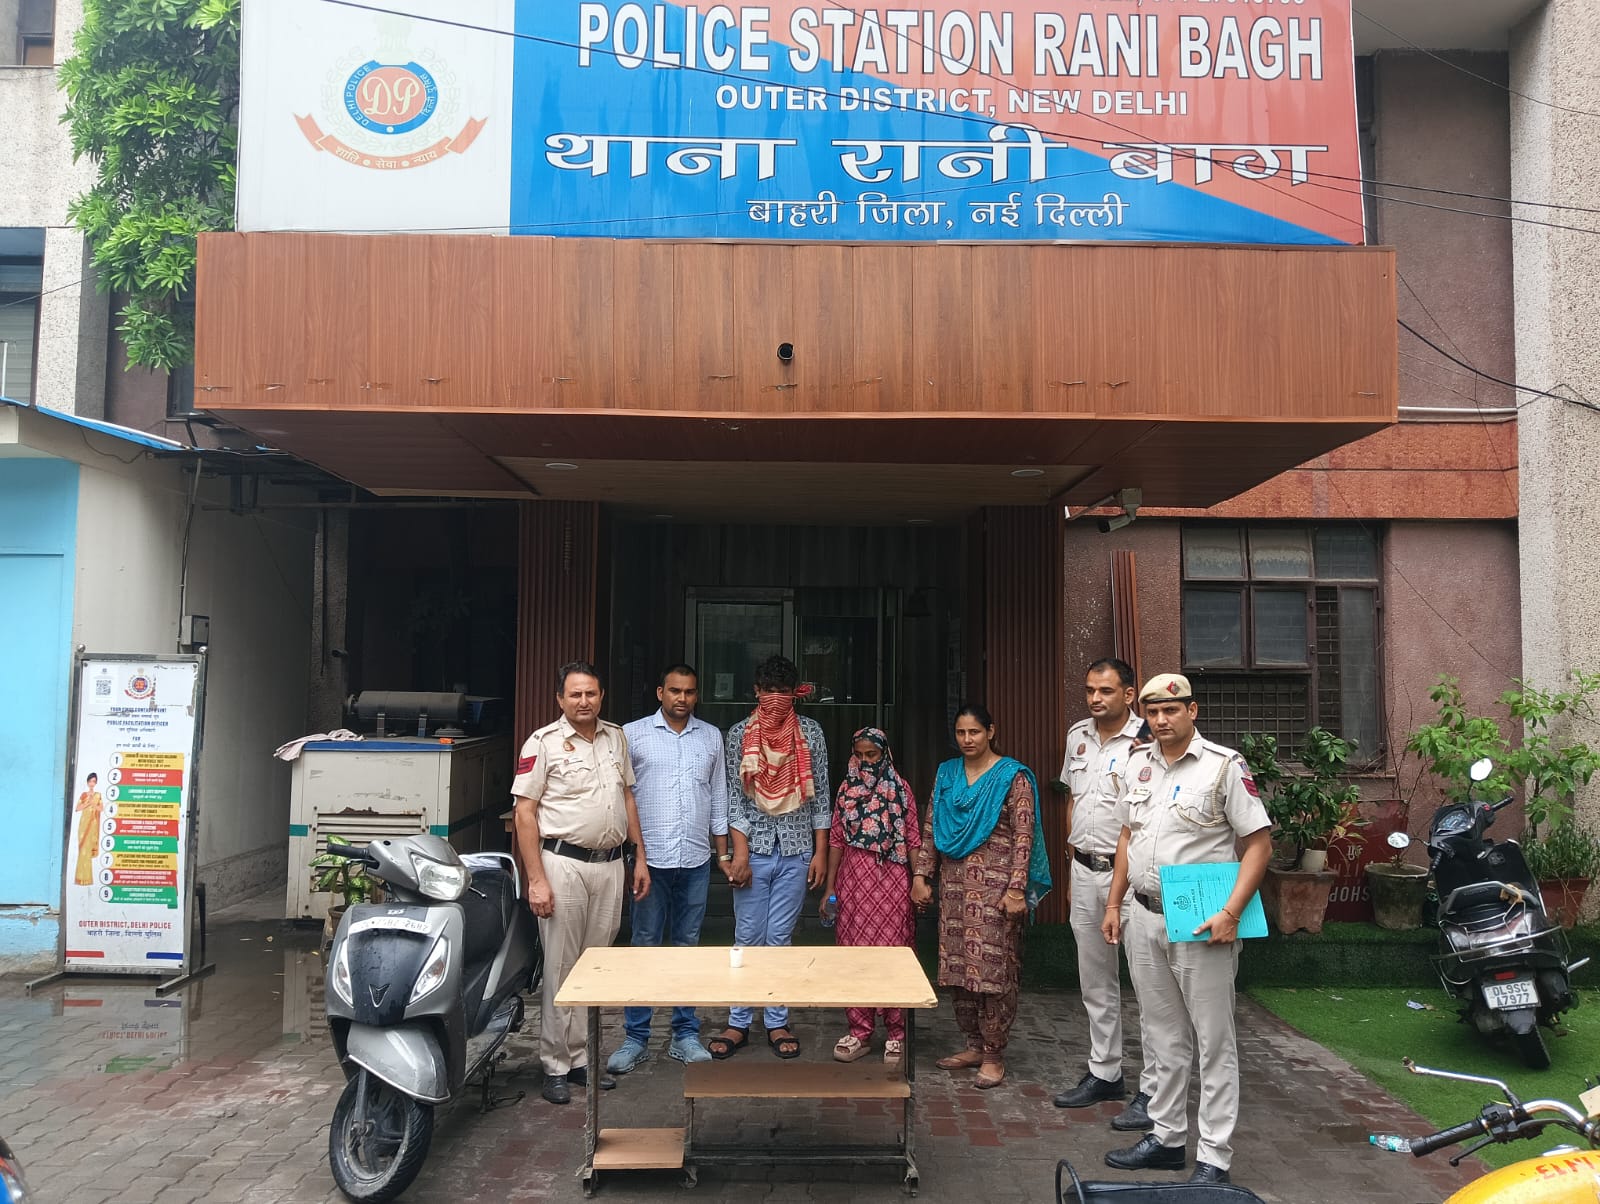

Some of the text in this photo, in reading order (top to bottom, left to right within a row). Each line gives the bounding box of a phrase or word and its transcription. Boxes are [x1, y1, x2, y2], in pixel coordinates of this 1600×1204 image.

[578, 2, 1323, 81] POLICE STATION RANI BAGH
[346, 65, 371, 126] DELHI POLICE
[716, 84, 1188, 118] OUTER DISTRICT, NEW DELHI
[545, 132, 797, 181] थाना
[831, 122, 1069, 185] रानी
[746, 190, 1130, 230] बाहरी जिला, नई दिल्ली
[1328, 886, 1370, 902] SHOP
[79, 920, 98, 928] OUTER
[130, 921, 149, 929] DELHI
[149, 922, 172, 930] POLICE
[1492, 982, 1528, 996] DL9SC
